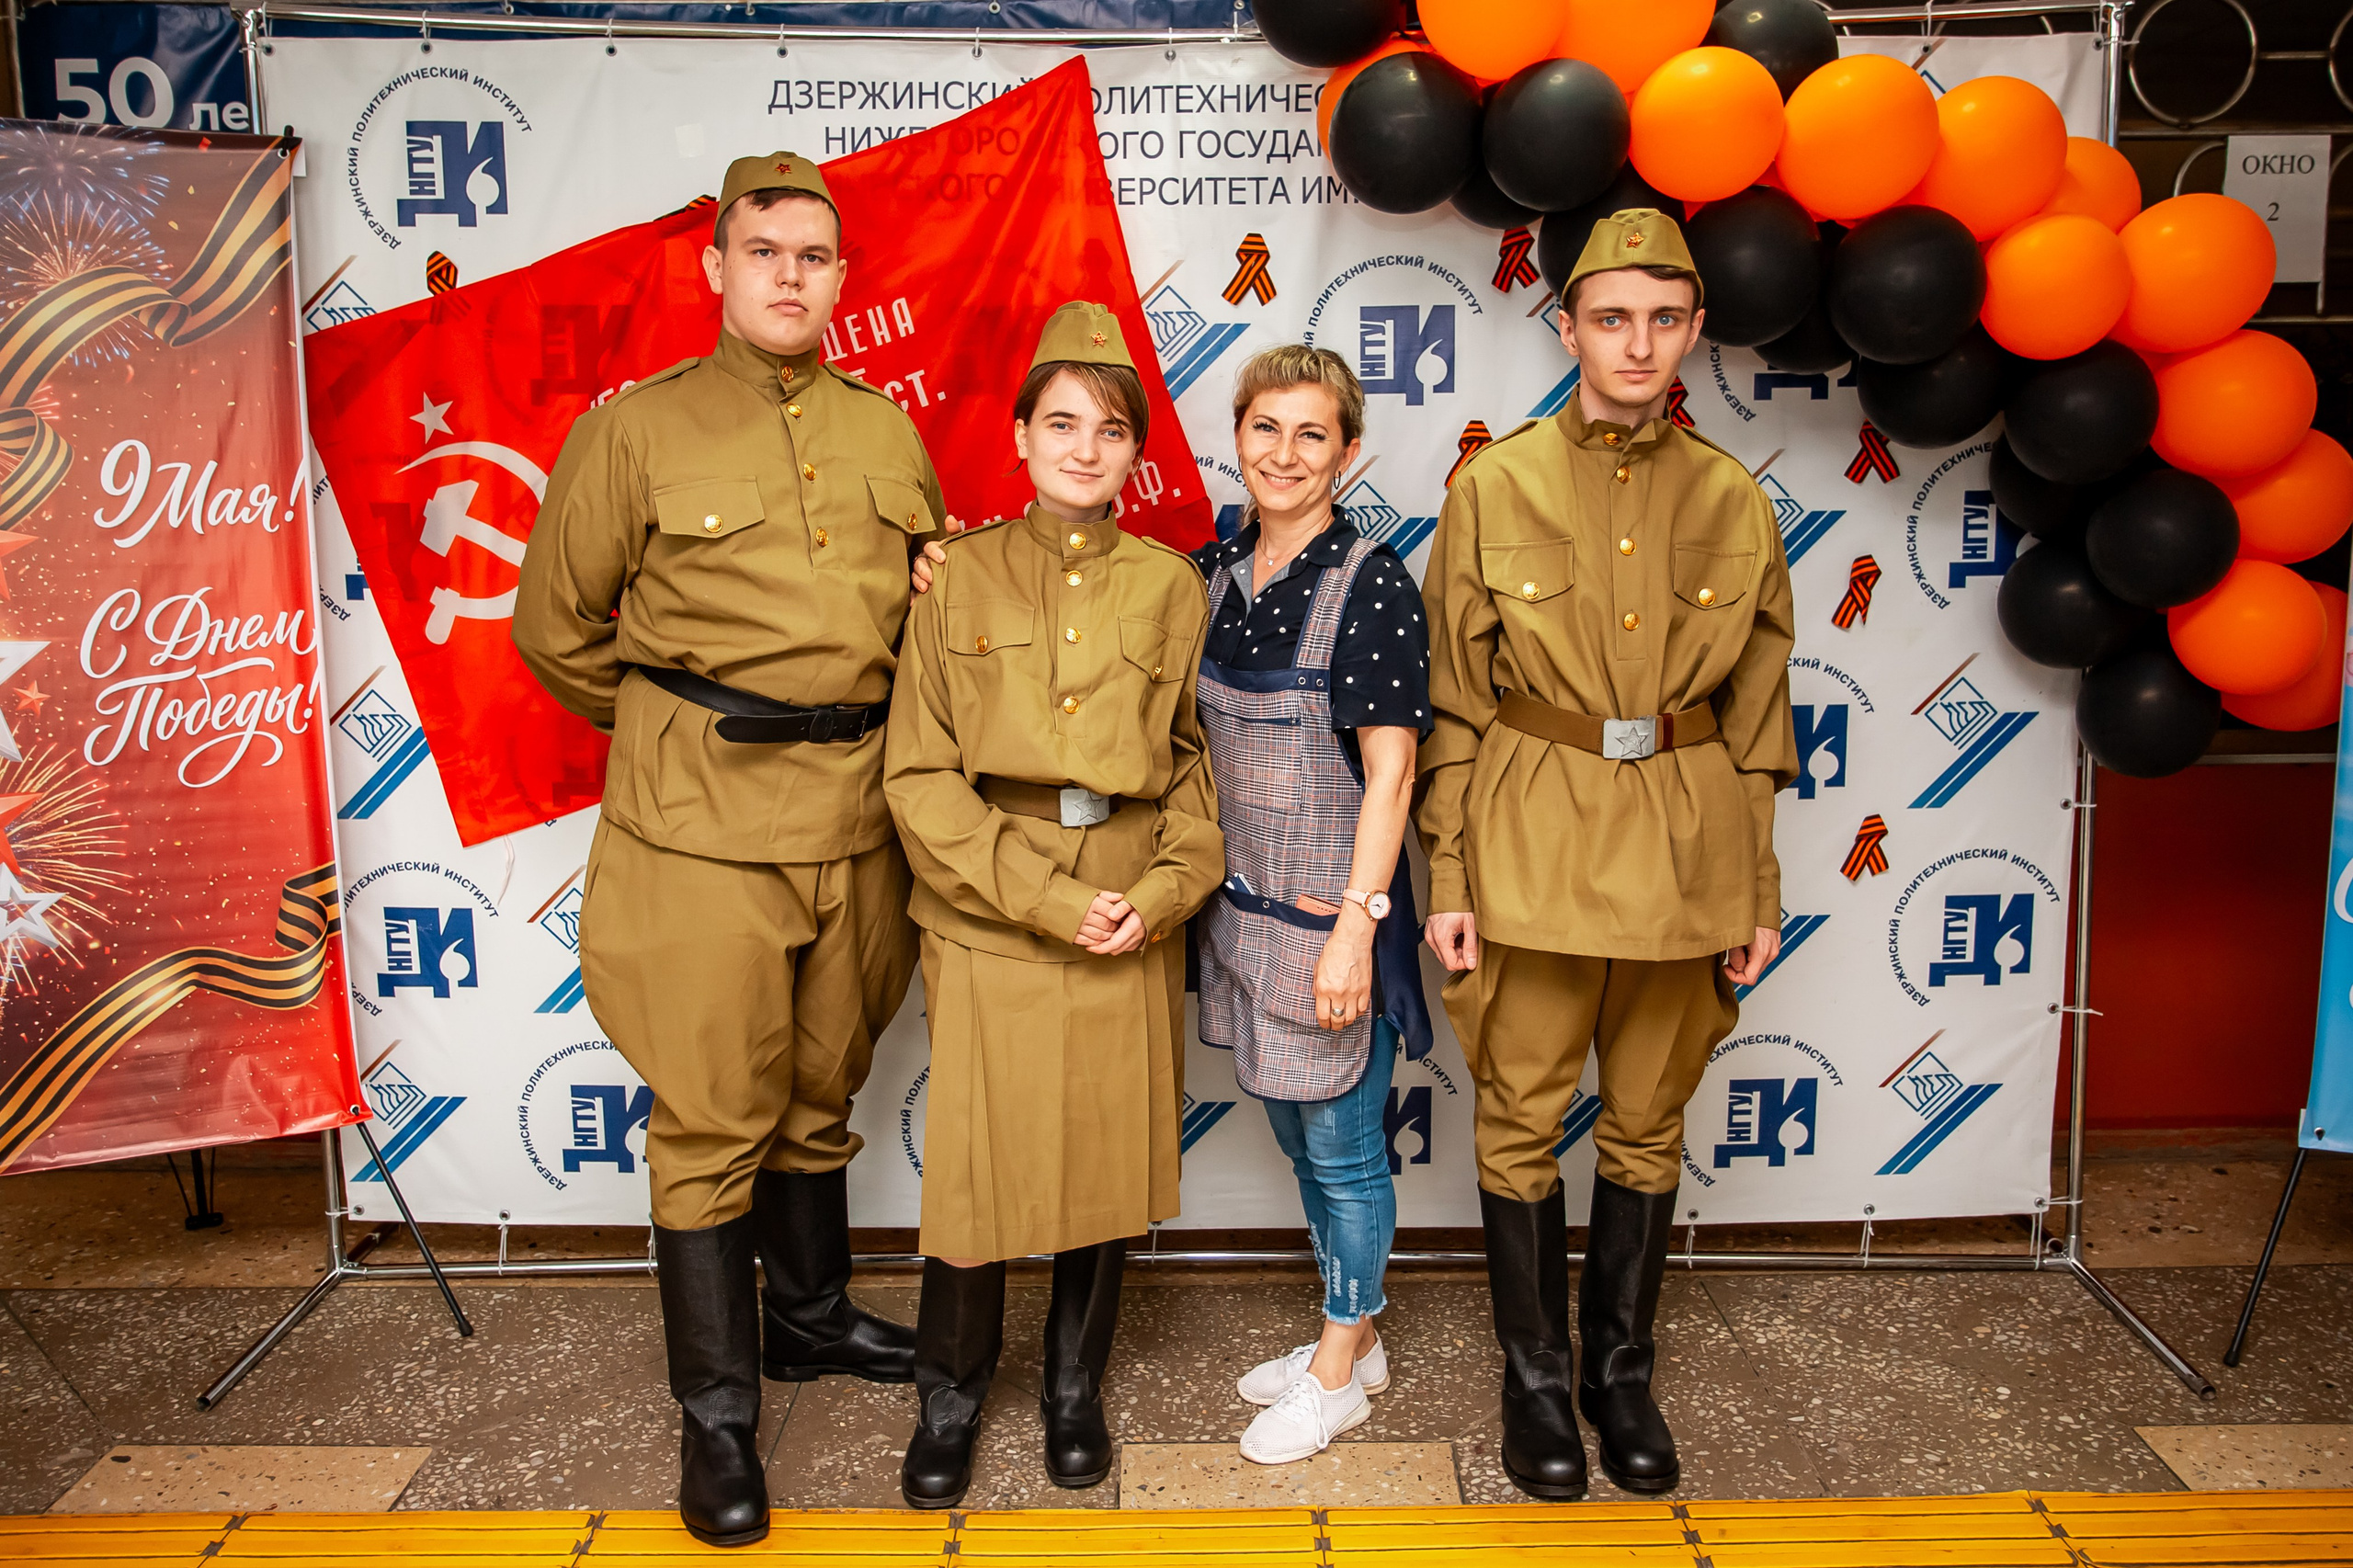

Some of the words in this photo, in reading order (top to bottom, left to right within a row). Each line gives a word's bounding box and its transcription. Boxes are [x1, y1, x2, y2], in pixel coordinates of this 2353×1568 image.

[55, 56, 174, 128] 50
[189, 102, 250, 131] ле
[352, 66, 469, 142] ПОЛИТЕХНИЧЕСКИЙ
[472, 75, 532, 132] ИНСТИТУТ
[767, 77, 1034, 115] ДЗЕРЖИНСКИ
[1178, 129, 1321, 164] ГОСУДА
[2242, 154, 2315, 175] ОКНО
[347, 147, 402, 250] ДЗЕРЖИНСКИЙ
[2266, 202, 2280, 222] 2
[1308, 255, 1425, 327] ПОЛИТЕХНИЧЕСКИЙ
[1427, 262, 1483, 315] ИНСТИТУТ
[822, 297, 915, 362] ДЕНА
[1710, 341, 1756, 423] ДЗЕРЖИНСК
[94, 439, 152, 529] 9
[113, 458, 308, 549] Мая!
[1912, 441, 1993, 511] ПОЛИТЕХНИЧЕ
[1906, 516, 1950, 610] ДЗЕРЖИНСКИЙ
[80, 588, 141, 679] С
[144, 586, 319, 666] Днем
[84, 657, 321, 789] Победы!
[1824, 664, 1874, 713] ИНСТИТУТ
[344, 861, 440, 913] ЛИТЕХНИЧЕСКИЙ
[444, 869, 499, 917] ИНСТИТУТ
[1893, 848, 2008, 915] ПОЛИТЕХНИЧЕСКИЙ
[2011, 855, 2061, 903] ИНСТИТУТ
[1888, 919, 1930, 1007] ДЗЕРЖИНСКИЙ
[521, 1040, 620, 1101] ПОЛИТЕХНИЧЕСКИ
[1794, 1040, 1844, 1086] ИНСТИТУТ
[517, 1106, 567, 1191] ДЗЕРЖИНСКИЙ
